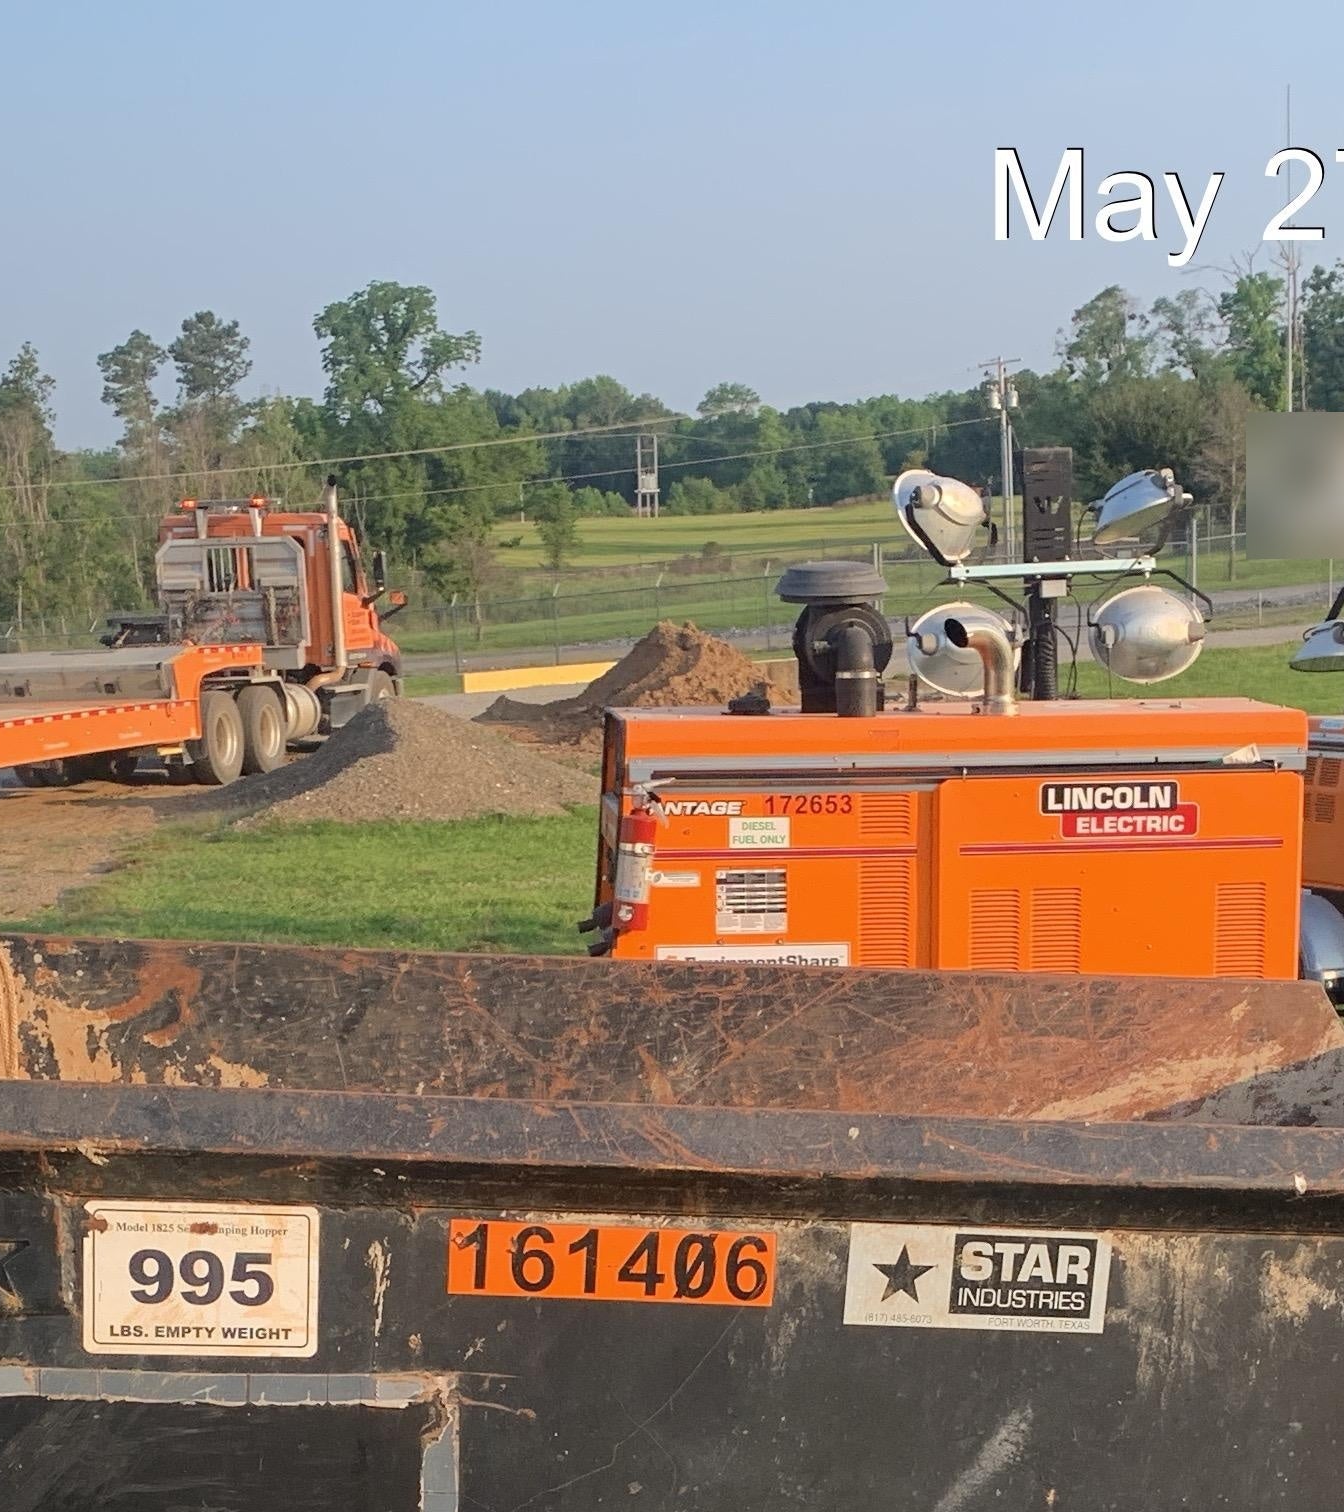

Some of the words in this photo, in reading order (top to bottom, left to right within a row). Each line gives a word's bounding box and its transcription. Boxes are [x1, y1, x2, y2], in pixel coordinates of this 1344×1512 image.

[765, 794, 853, 815] 172653
[1047, 786, 1172, 811] LINCOLN
[741, 822, 777, 831] DIESEL
[1076, 815, 1185, 834] ELECTRIC
[732, 835, 758, 845] FUEL
[760, 834, 787, 845] ONLY
[116, 1222, 148, 1232] Model
[151, 1223, 175, 1233] 1825
[250, 1226, 289, 1238] Hopper
[456, 1223, 769, 1302] 161406
[959, 1241, 1092, 1286] STAR
[128, 1249, 275, 1307] 995
[957, 1286, 1087, 1311] INDUSTRIES
[109, 1325, 149, 1338] LBS.
[155, 1325, 216, 1339] EMPTY
[221, 1326, 293, 1340] WEIGHT
[987, 1317, 1014, 1327] FORT
[1058, 1319, 1090, 1330] TEXAS
